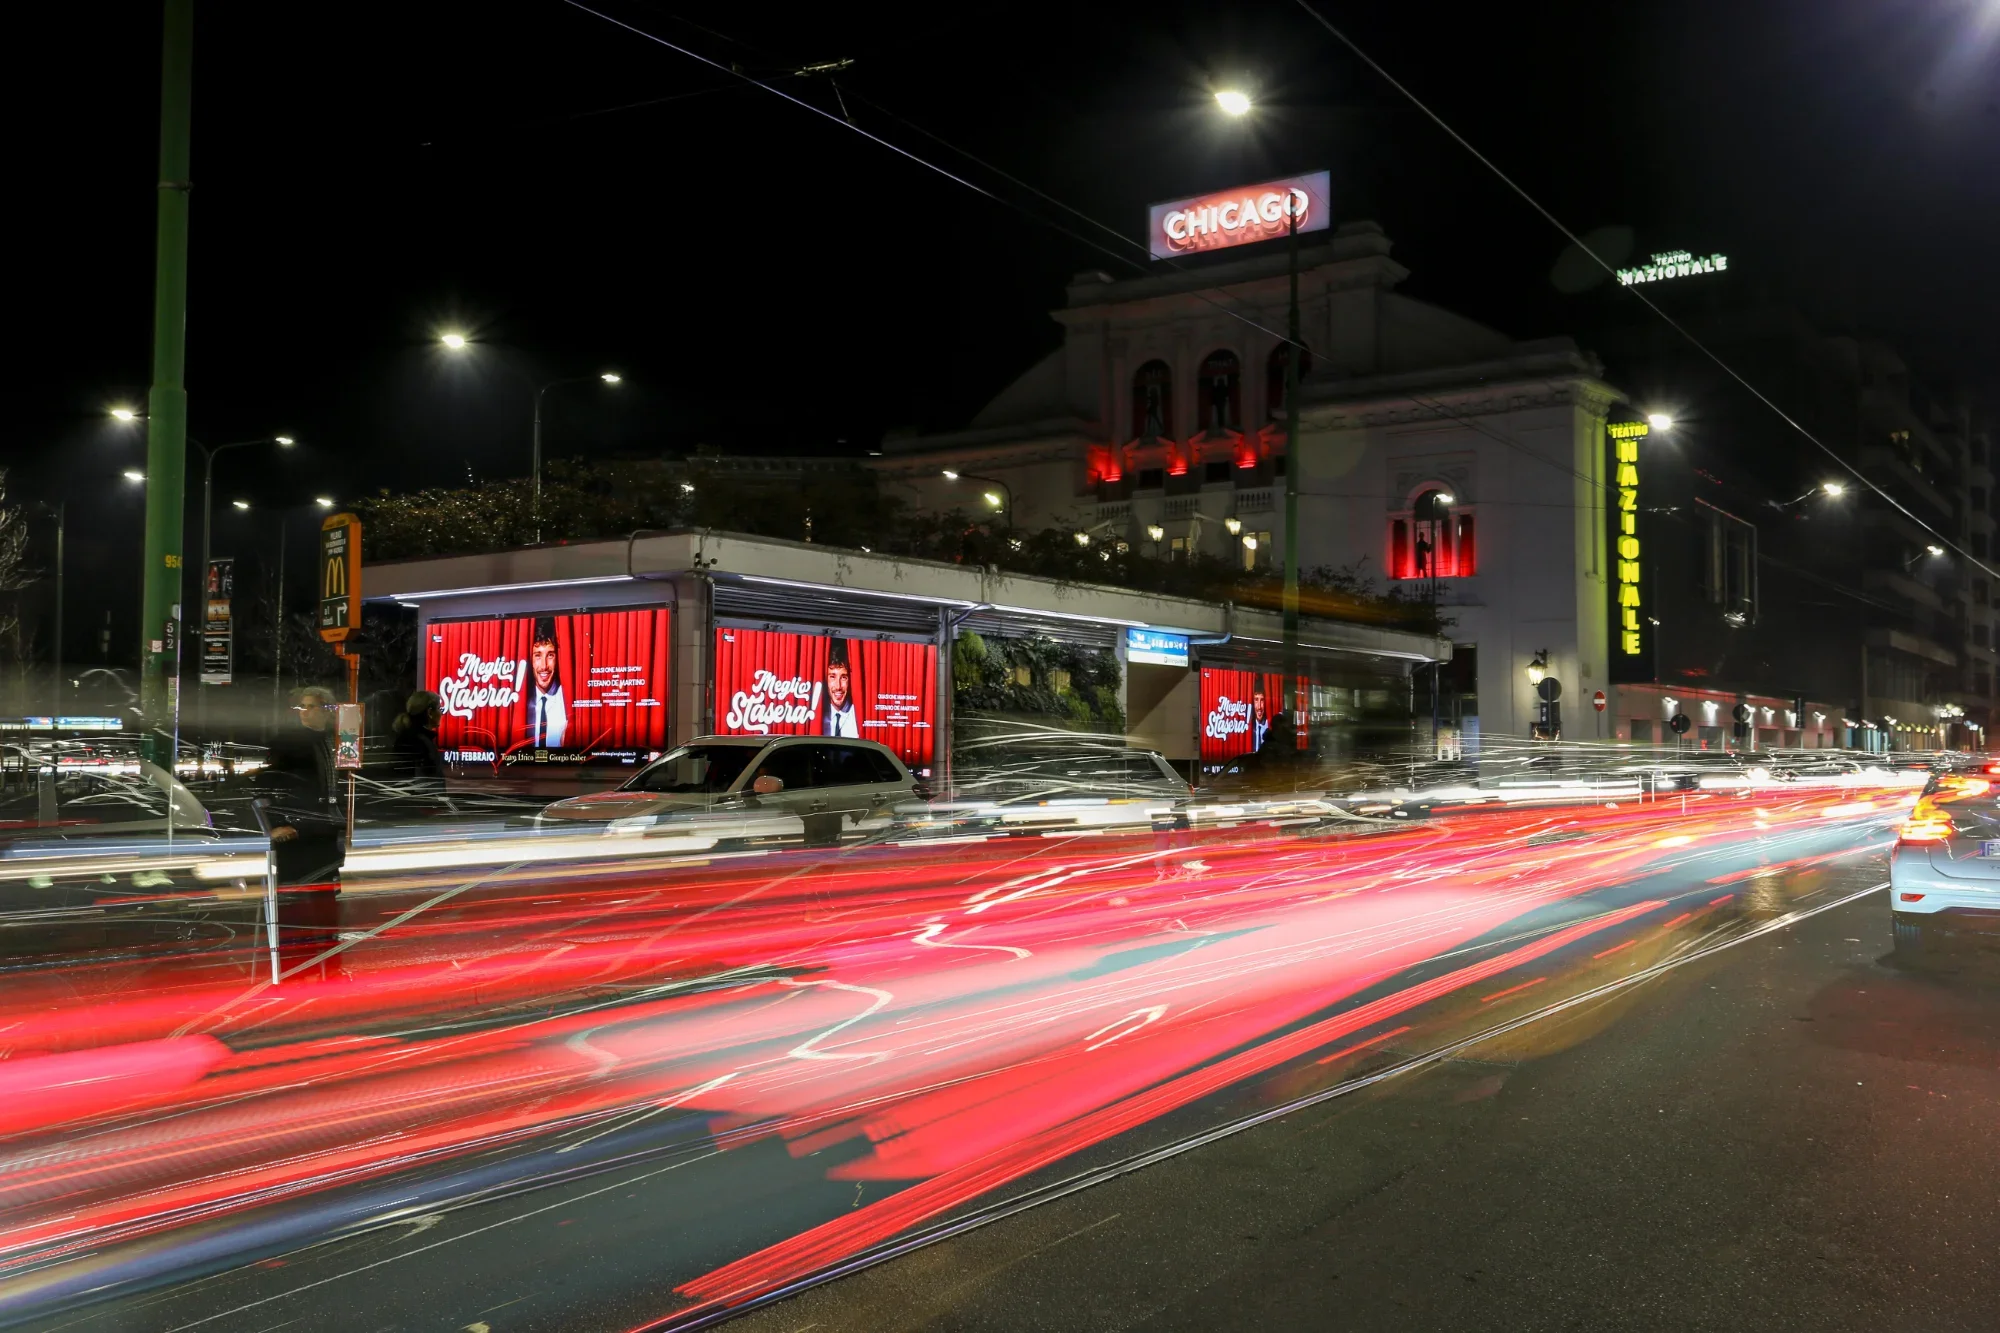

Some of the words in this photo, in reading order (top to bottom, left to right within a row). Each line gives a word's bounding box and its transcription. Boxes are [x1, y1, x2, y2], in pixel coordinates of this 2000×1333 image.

[1164, 187, 1309, 241] CHICAGO
[1619, 256, 1727, 285] NAZIONALE
[1653, 252, 1691, 265] TEATRO
[1609, 423, 1648, 438] TEATRO
[1617, 440, 1640, 655] NAZIONALE
[458, 652, 515, 683] Meglio
[752, 669, 812, 700] Meglio
[1218, 696, 1247, 717] Meglio
[444, 751, 459, 762] 8/11
[461, 751, 495, 761] FEBBRAIO
[549, 753, 570, 762] Giorgio
